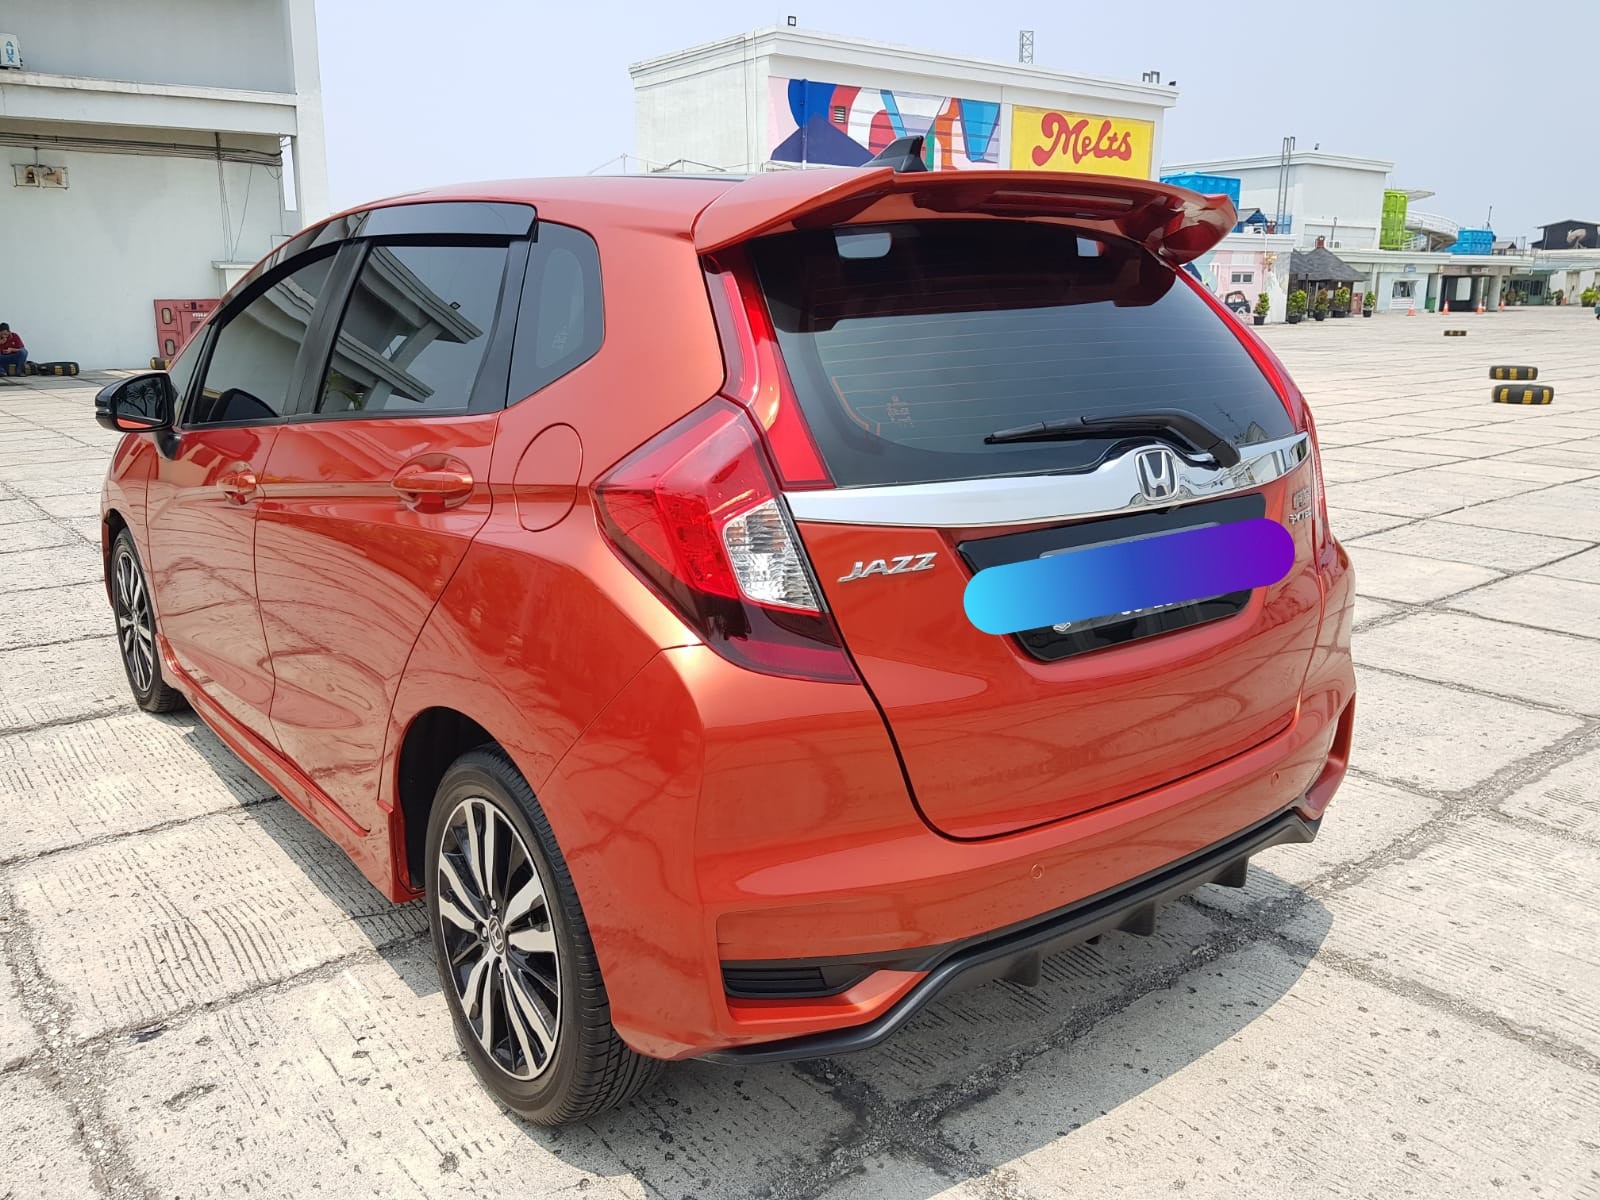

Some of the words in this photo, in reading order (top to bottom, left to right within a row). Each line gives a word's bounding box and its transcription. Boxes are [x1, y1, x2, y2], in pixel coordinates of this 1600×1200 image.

[5, 40, 15, 64] AUX
[1031, 111, 1133, 167] Melts
[837, 552, 938, 583] JAZZ
